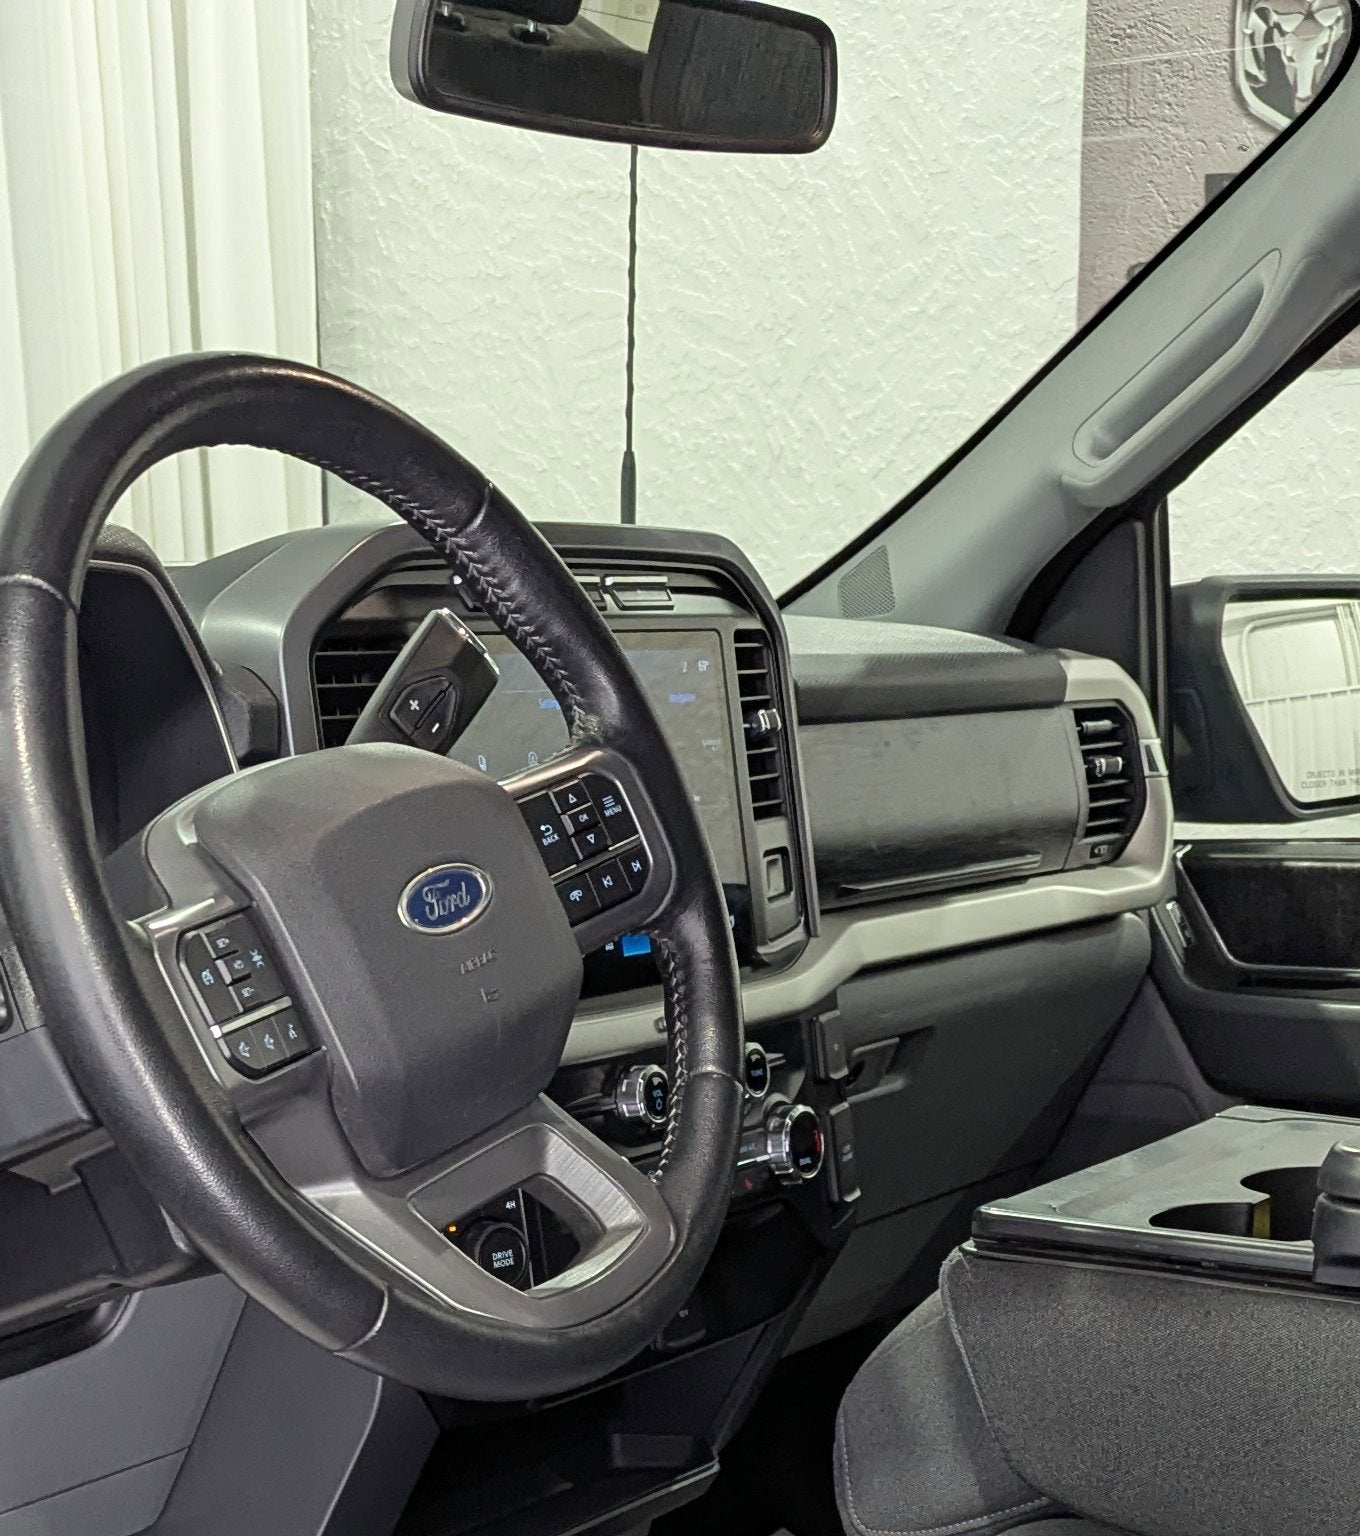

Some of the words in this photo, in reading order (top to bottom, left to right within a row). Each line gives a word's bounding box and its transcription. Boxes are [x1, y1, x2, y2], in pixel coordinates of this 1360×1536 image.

[603, 804, 623, 817] MENU
[542, 832, 560, 847] BACK
[422, 878, 471, 921] Ford
[492, 1249, 514, 1261] DRIVE
[493, 1257, 515, 1269] MODE
